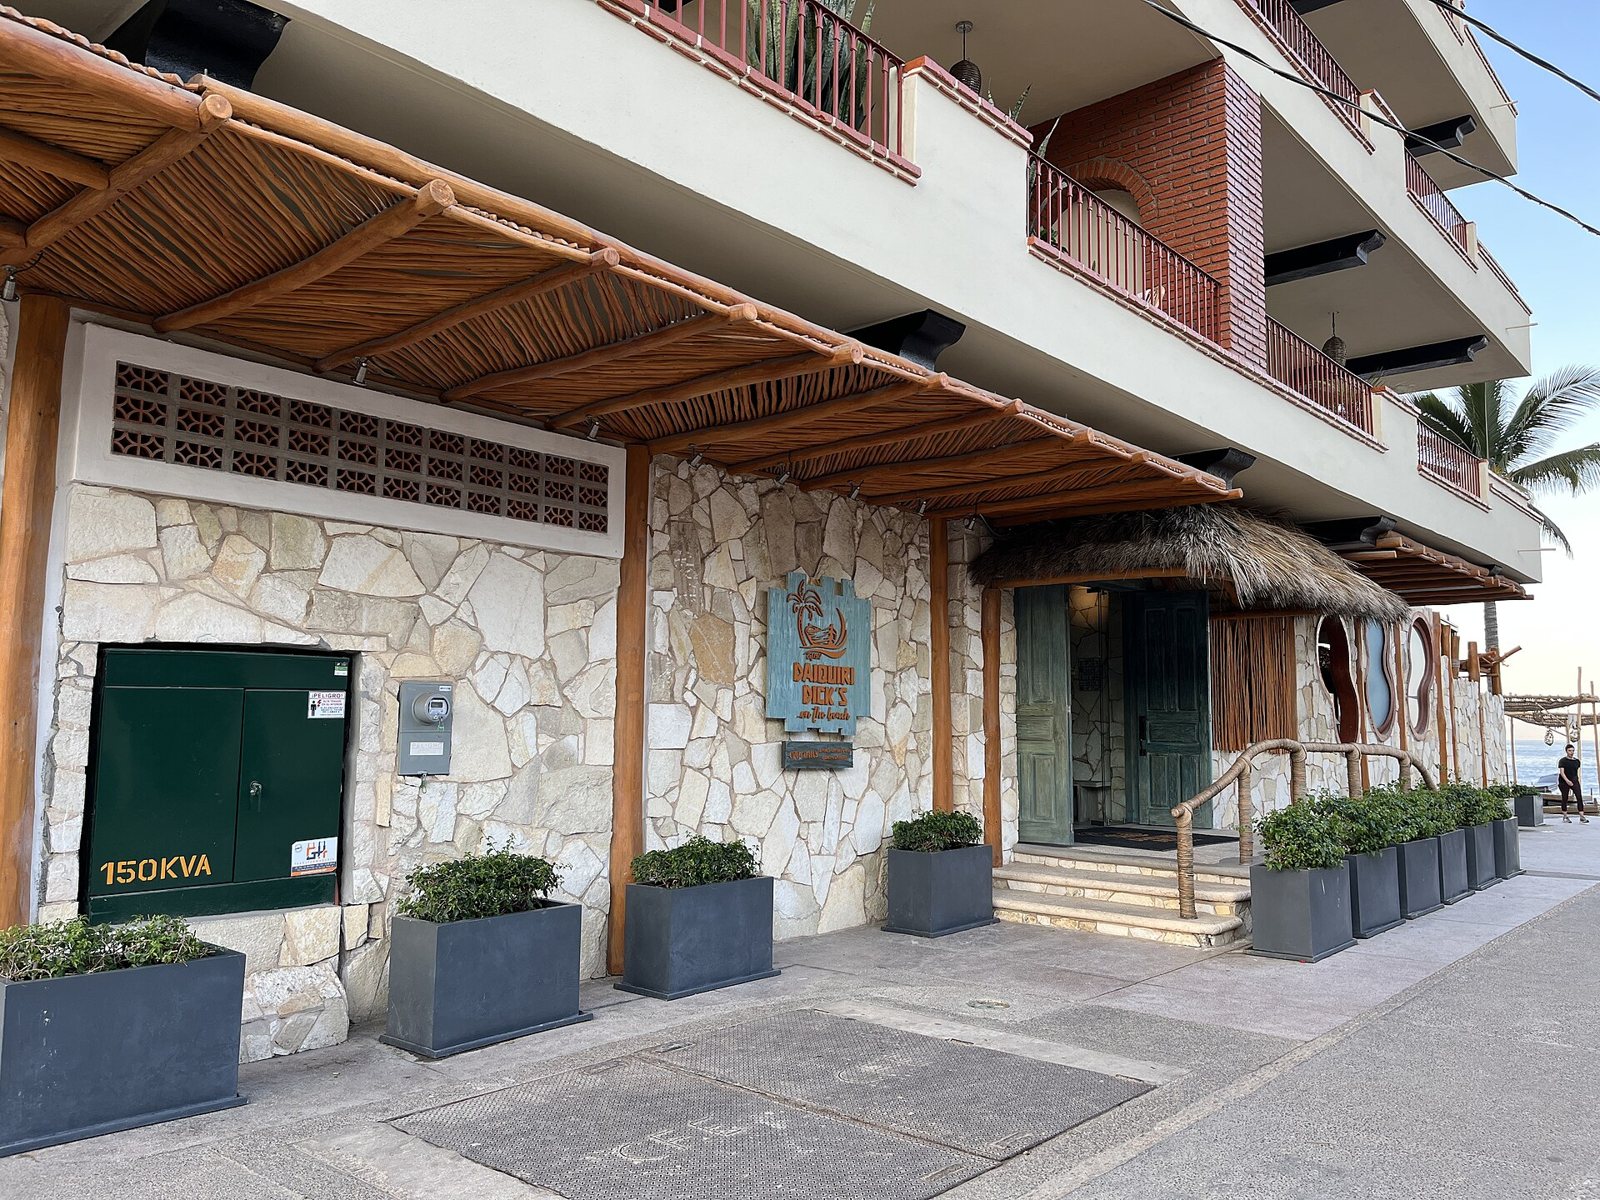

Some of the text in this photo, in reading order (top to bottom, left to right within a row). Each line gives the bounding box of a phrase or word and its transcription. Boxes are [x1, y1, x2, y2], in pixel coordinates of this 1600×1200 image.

[793, 662, 855, 685] DAIQUIRI
[802, 685, 848, 706] DICK'S
[101, 854, 212, 885] 150KVA
